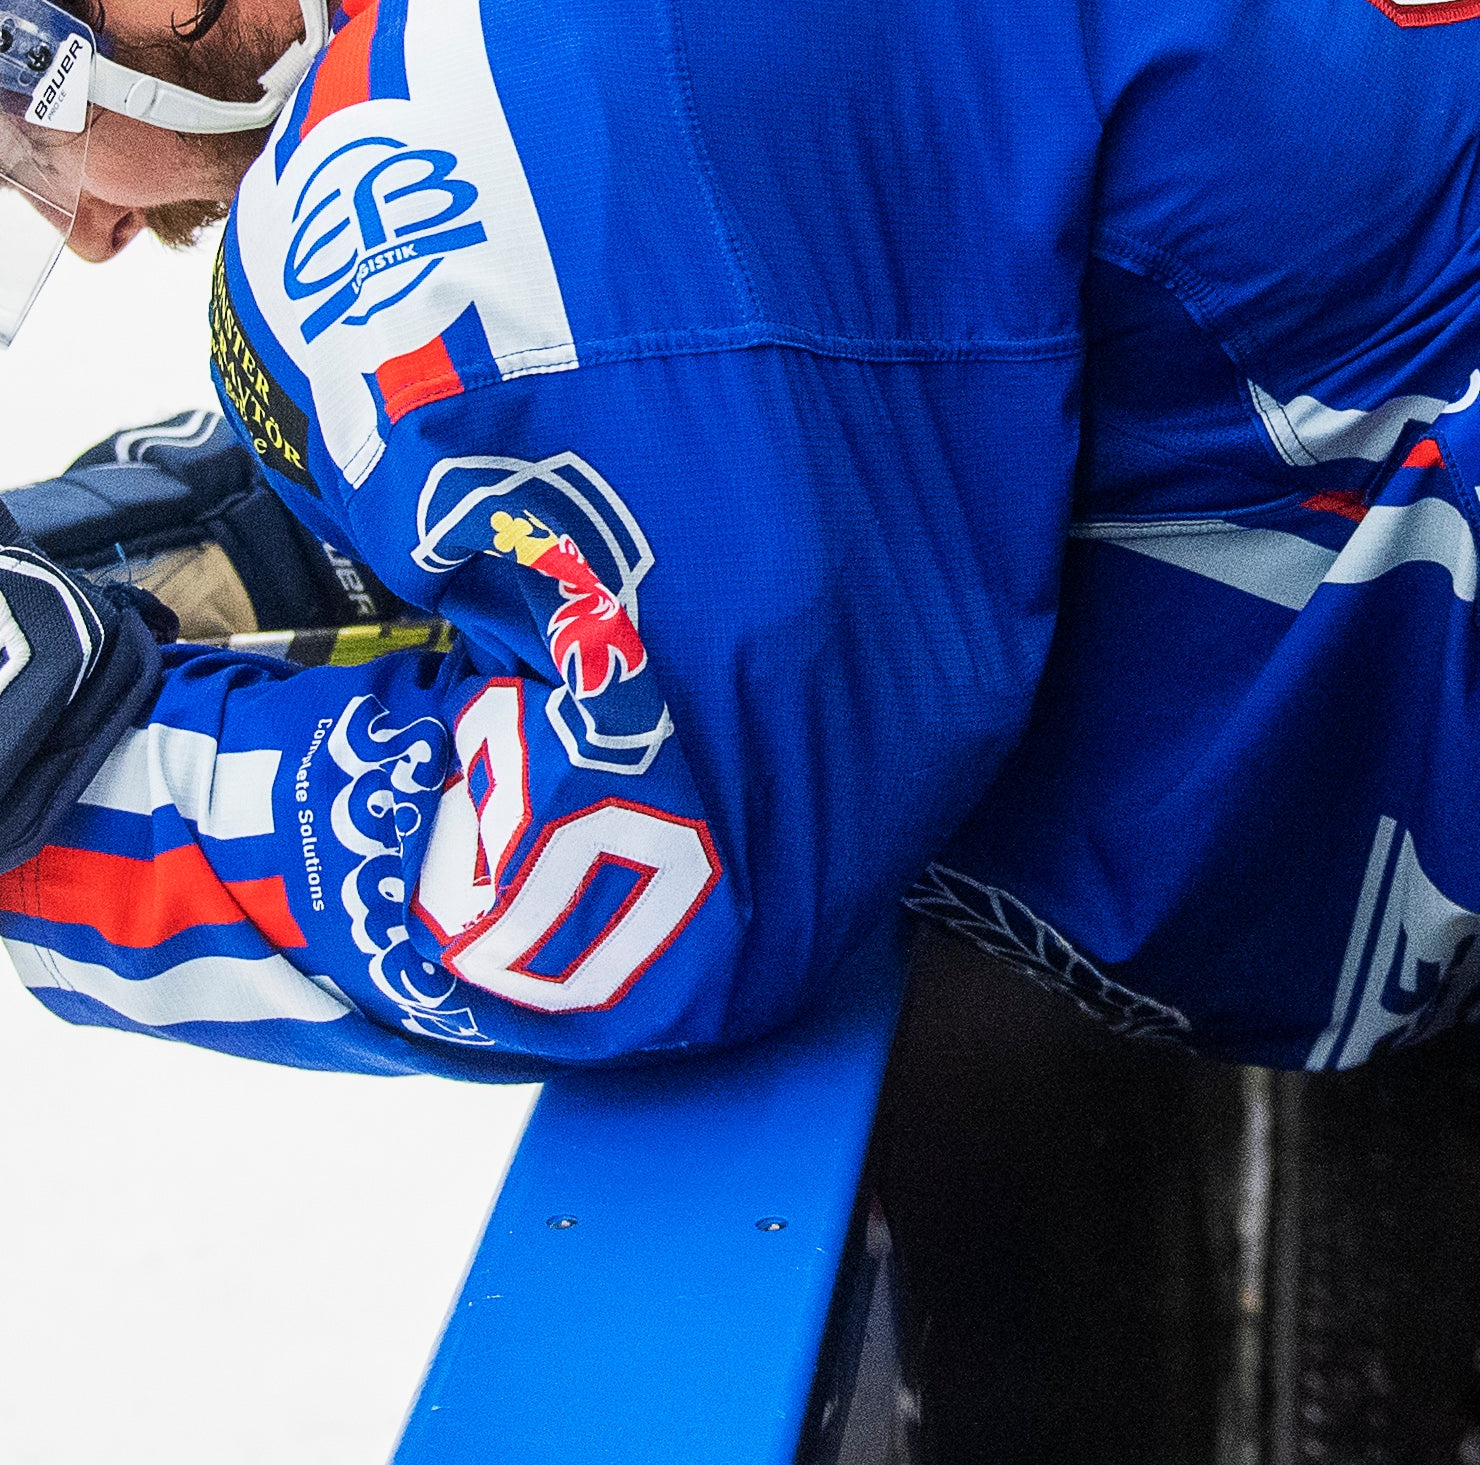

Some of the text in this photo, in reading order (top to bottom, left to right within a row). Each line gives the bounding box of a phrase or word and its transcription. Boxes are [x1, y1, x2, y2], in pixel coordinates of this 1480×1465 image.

[34, 39, 83, 120] BAUER
[295, 717, 334, 802] Complete
[297, 809, 325, 913] Solutions
